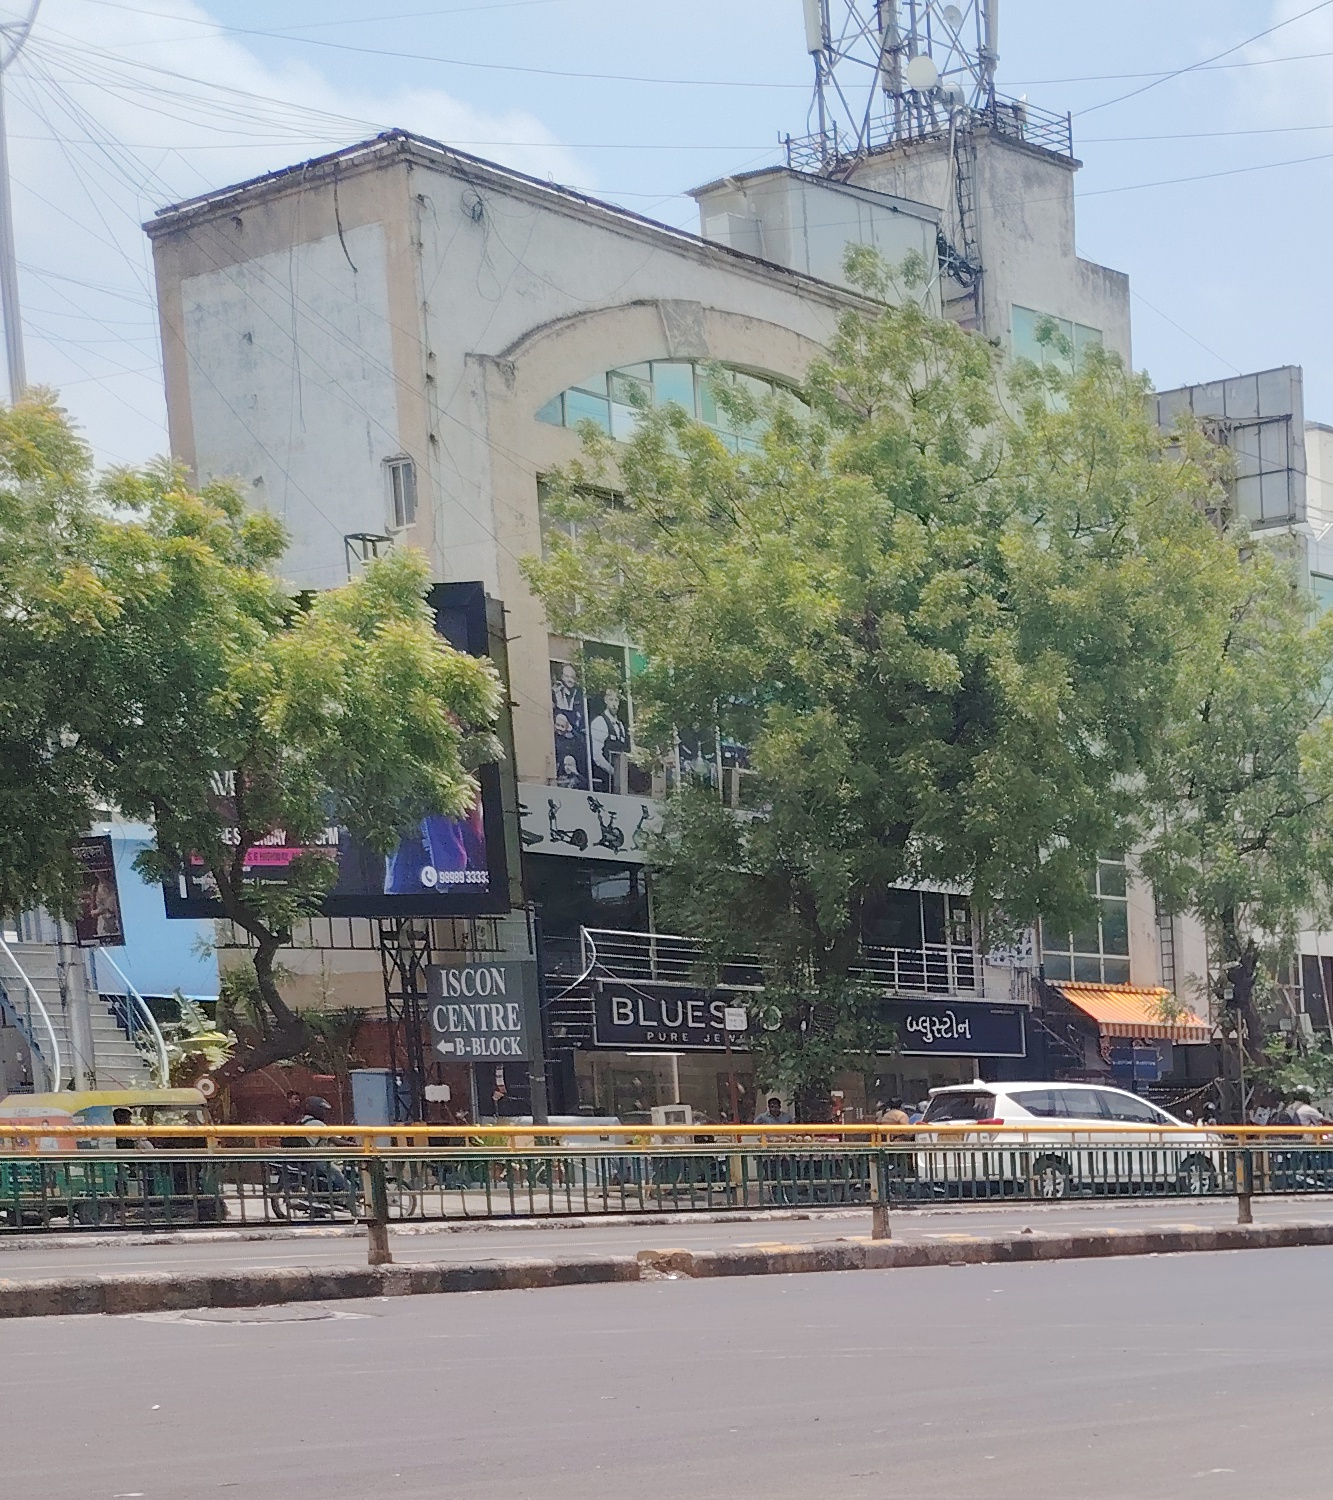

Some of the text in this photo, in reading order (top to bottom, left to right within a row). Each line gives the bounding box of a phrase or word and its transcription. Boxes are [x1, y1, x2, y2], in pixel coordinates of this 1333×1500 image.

[440, 967, 506, 997] ISCON
[432, 1003, 521, 1033] CENTRE
[906, 1010, 972, 1044] બ્લુસ્ટોન
[454, 1036, 523, 1057] B-BLOCK
[646, 1031, 690, 1043] PURE
